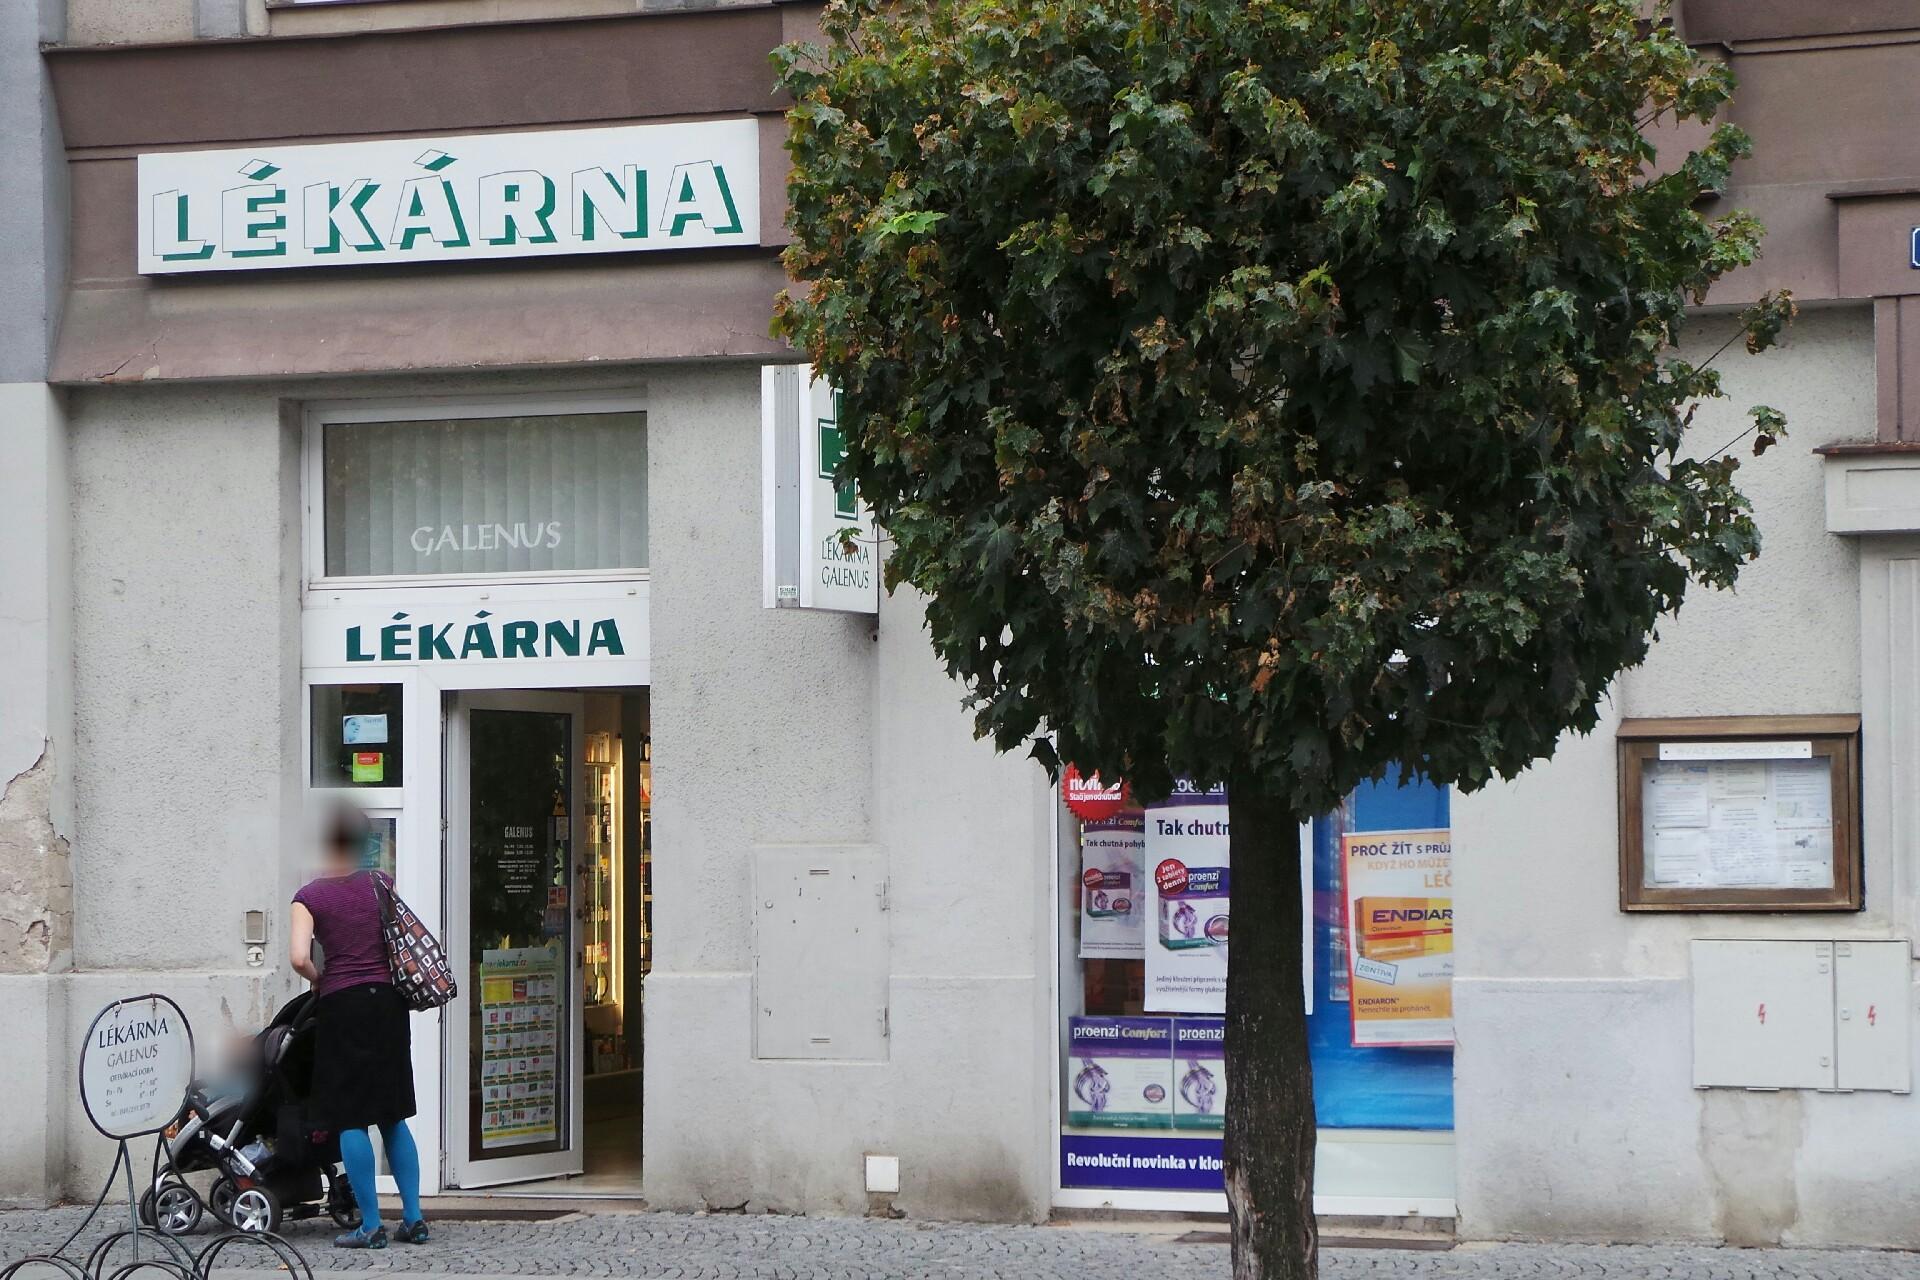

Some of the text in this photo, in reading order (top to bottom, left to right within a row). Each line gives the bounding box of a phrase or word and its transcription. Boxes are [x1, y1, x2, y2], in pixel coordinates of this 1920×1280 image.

[152, 149, 743, 261] LÉKÁRNA
[411, 521, 561, 556] GALENUS
[822, 566, 869, 589] GALENUS
[346, 610, 625, 662] LÉKÁRNA
[504, 826, 533, 838] GALENUS
[1157, 820, 1184, 836] Tak
[1099, 839, 1123, 848] chutná
[1352, 842, 1388, 857] PROČ
[1391, 841, 1412, 855] ŽÍT
[1161, 863, 1176, 874] Jen
[1400, 860, 1416, 869] HO
[1163, 877, 1186, 890] denně
[1189, 871, 1219, 882] proenzi
[1189, 883, 1219, 893] Comfort
[1360, 964, 1392, 977] ZENTIVA
[99, 1017, 169, 1049] LÉKÁRNA
[1073, 1025, 1168, 1040] proenzi Comfort
[1179, 1027, 1224, 1041] proenzi
[107, 1044, 158, 1069] GALENUS
[1067, 1153, 1130, 1168] Revoluční
[1133, 1156, 1186, 1170] novinka
[1188, 1160, 1197, 1169] v
